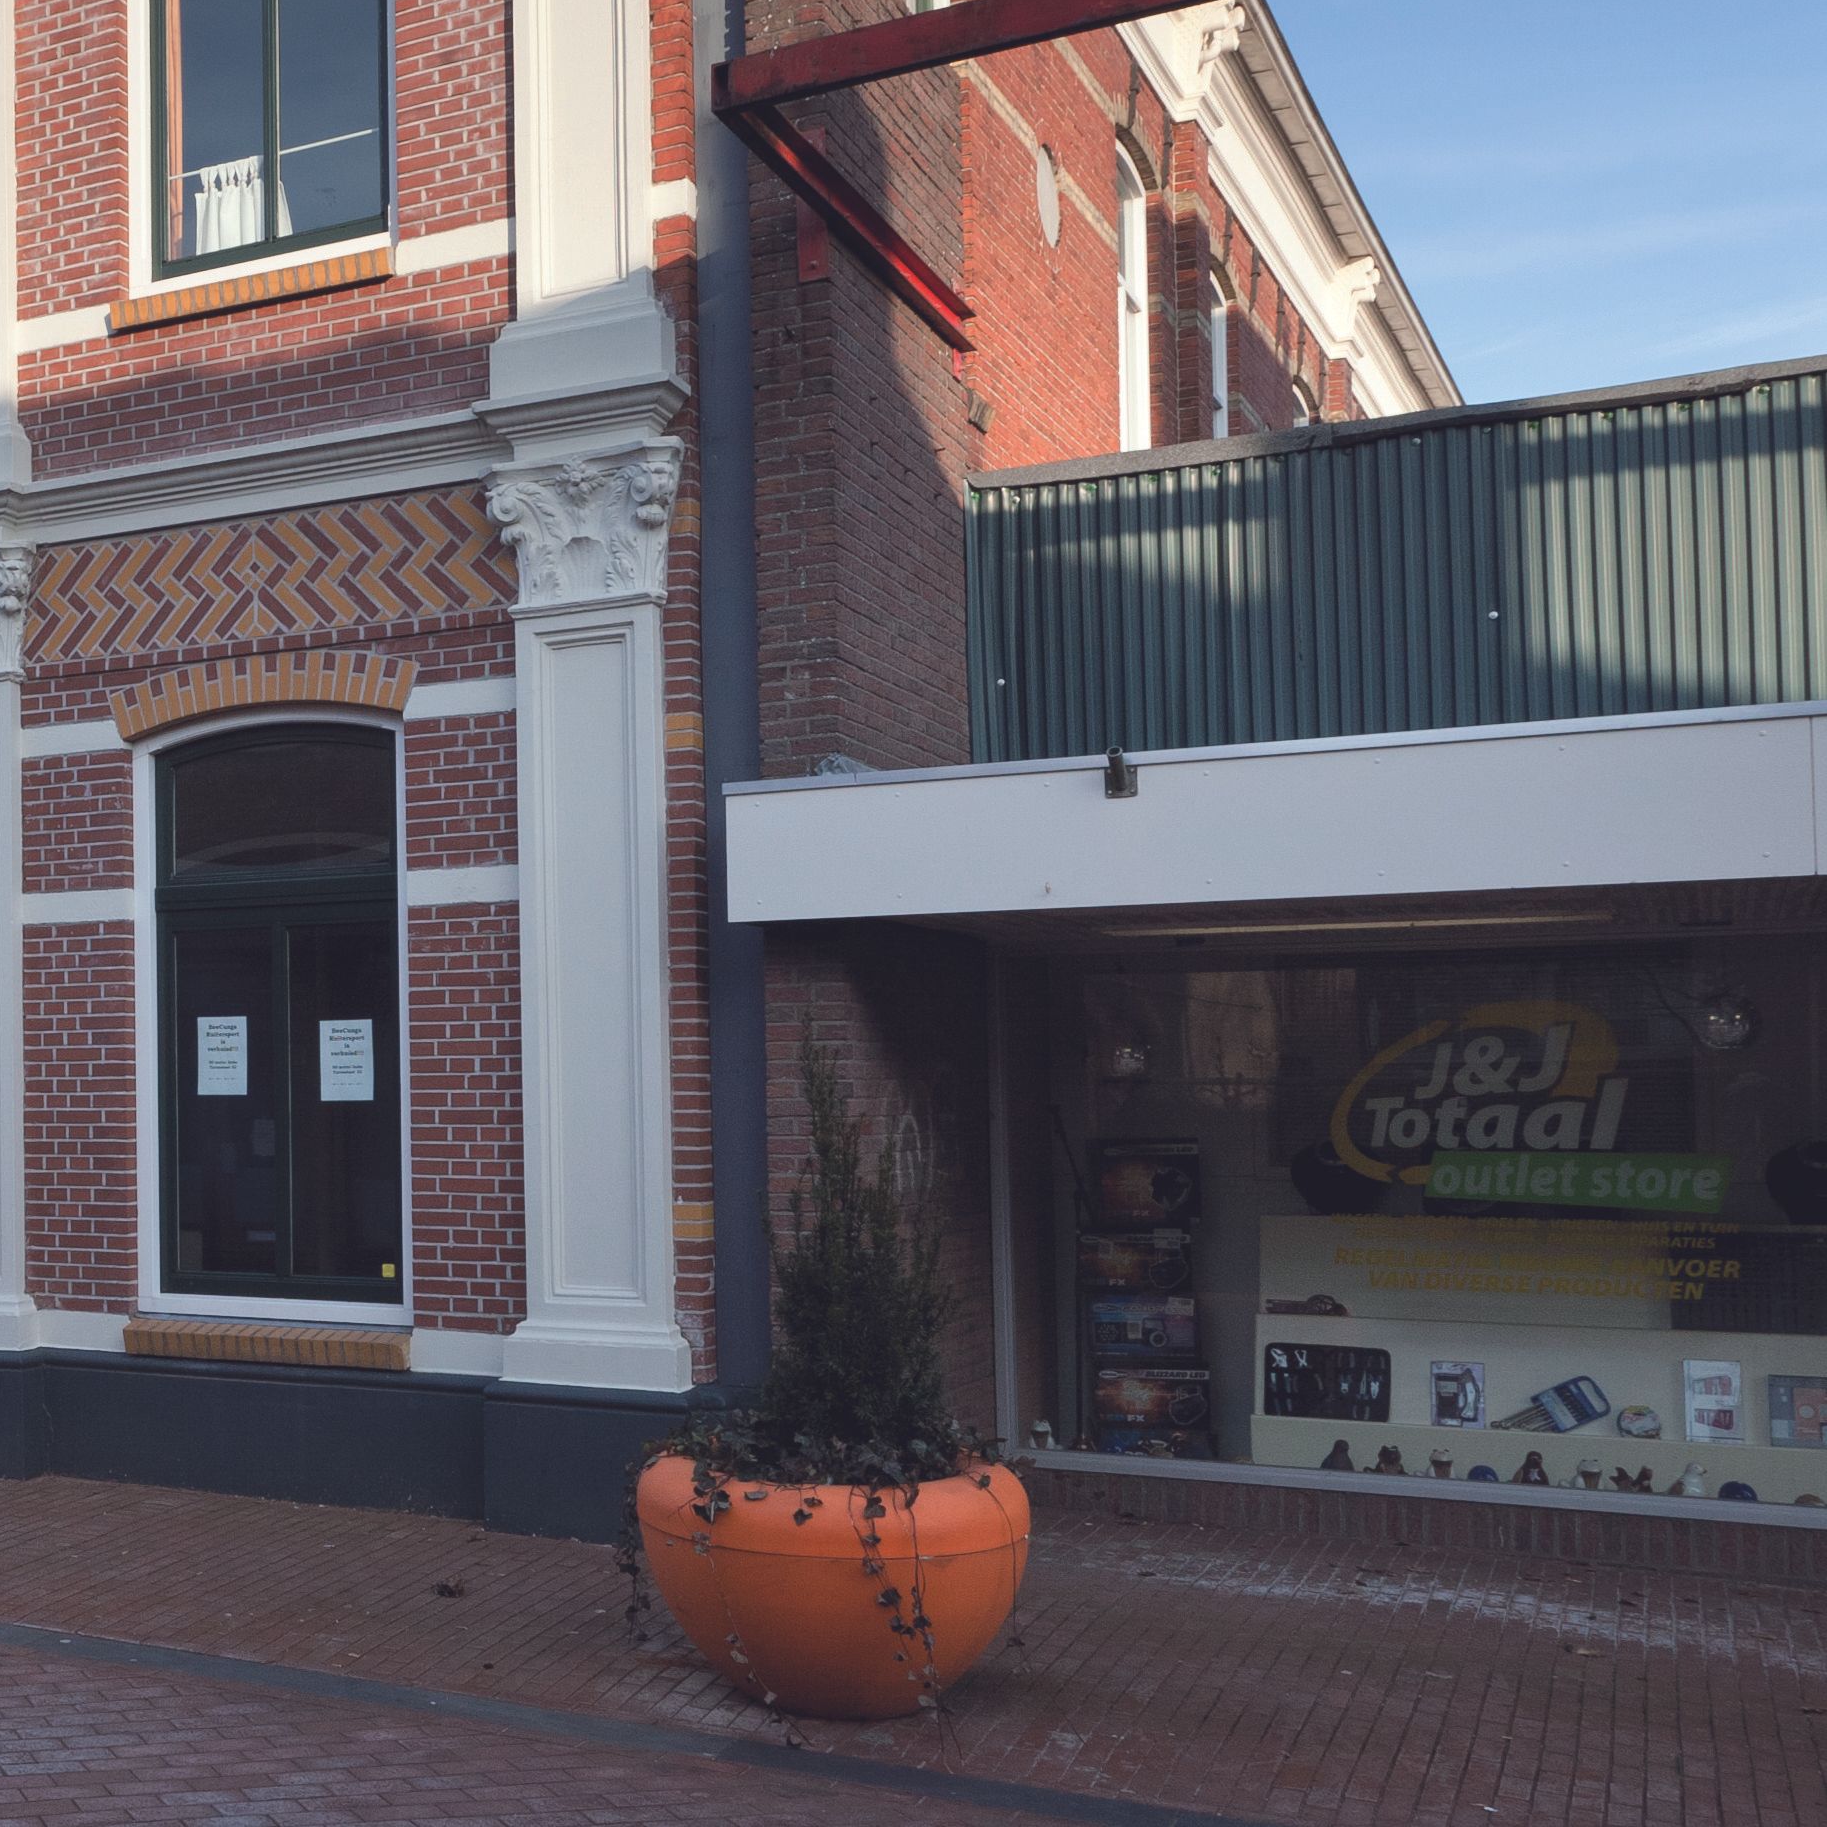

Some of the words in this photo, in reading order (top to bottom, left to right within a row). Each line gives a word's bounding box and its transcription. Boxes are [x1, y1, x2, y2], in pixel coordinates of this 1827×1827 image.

[1414, 1021, 1574, 1100] J&J
[1364, 1077, 1630, 1151] Totaal
[1430, 1154, 1580, 1198] outlet
[1590, 1159, 1724, 1201] store
[1673, 1221, 1696, 1233] EN
[1369, 1271, 1419, 1290] VAN
[1423, 1272, 1531, 1293] DIVERSE
[1537, 1276, 1705, 1301] PRODUCTEN
[1126, 1413, 1146, 1422] FX
